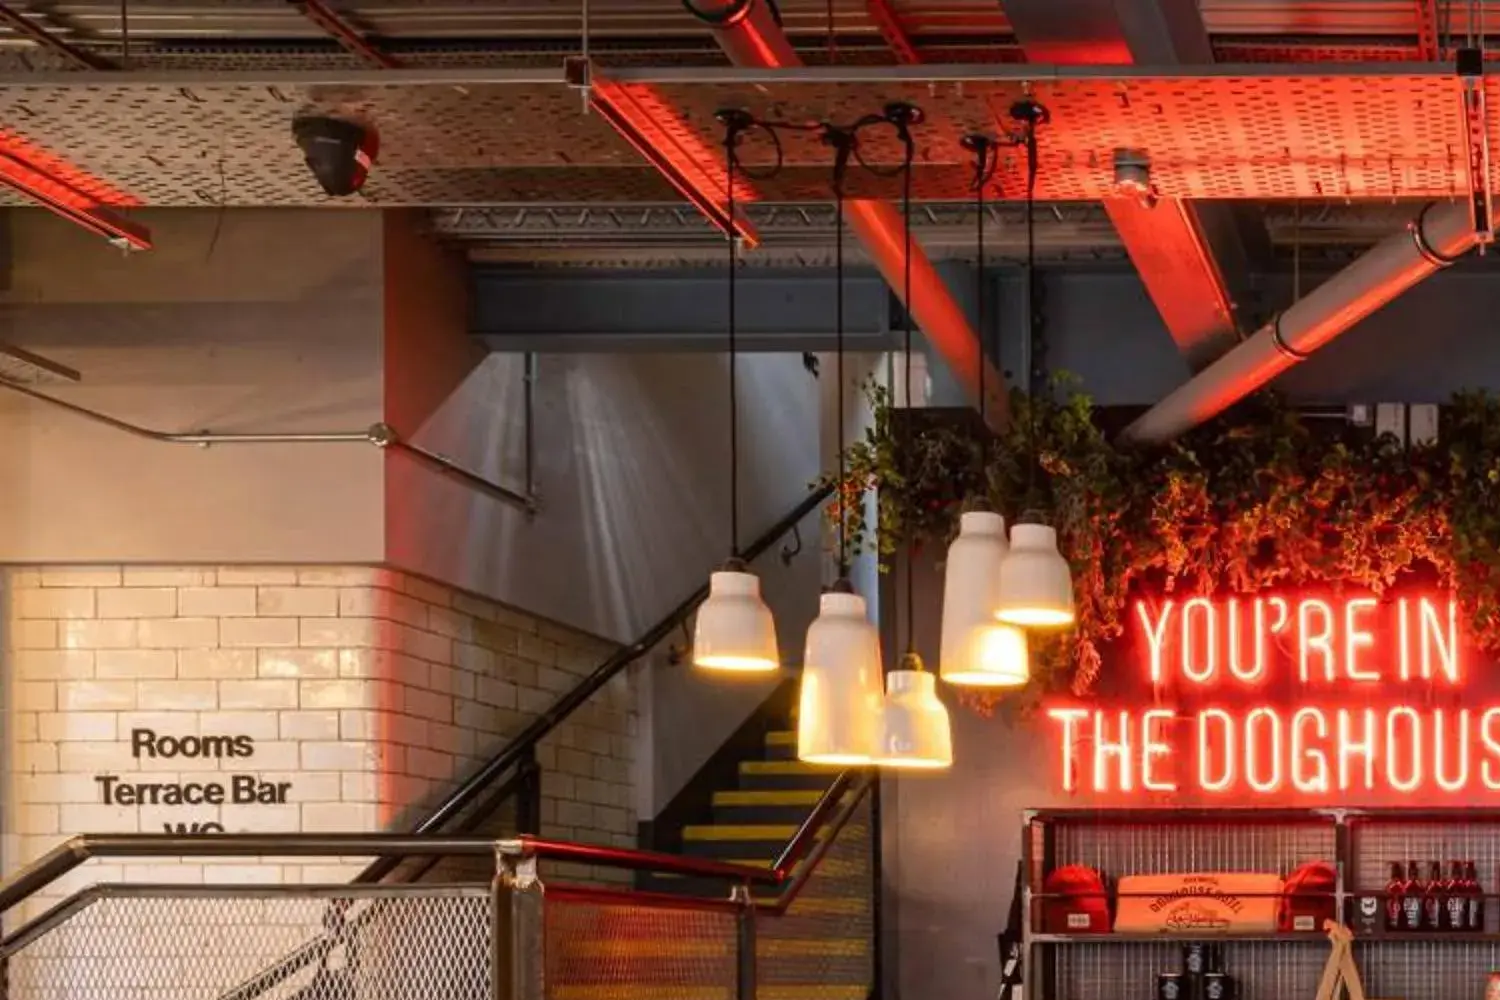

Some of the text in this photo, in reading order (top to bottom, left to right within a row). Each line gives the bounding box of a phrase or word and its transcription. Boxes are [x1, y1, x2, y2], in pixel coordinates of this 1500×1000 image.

[1134, 594, 1462, 684] YOU'RE IN
[130, 727, 255, 759] Rooms
[1045, 705, 1177, 793] THE
[94, 773, 292, 807] Terrace Bar
